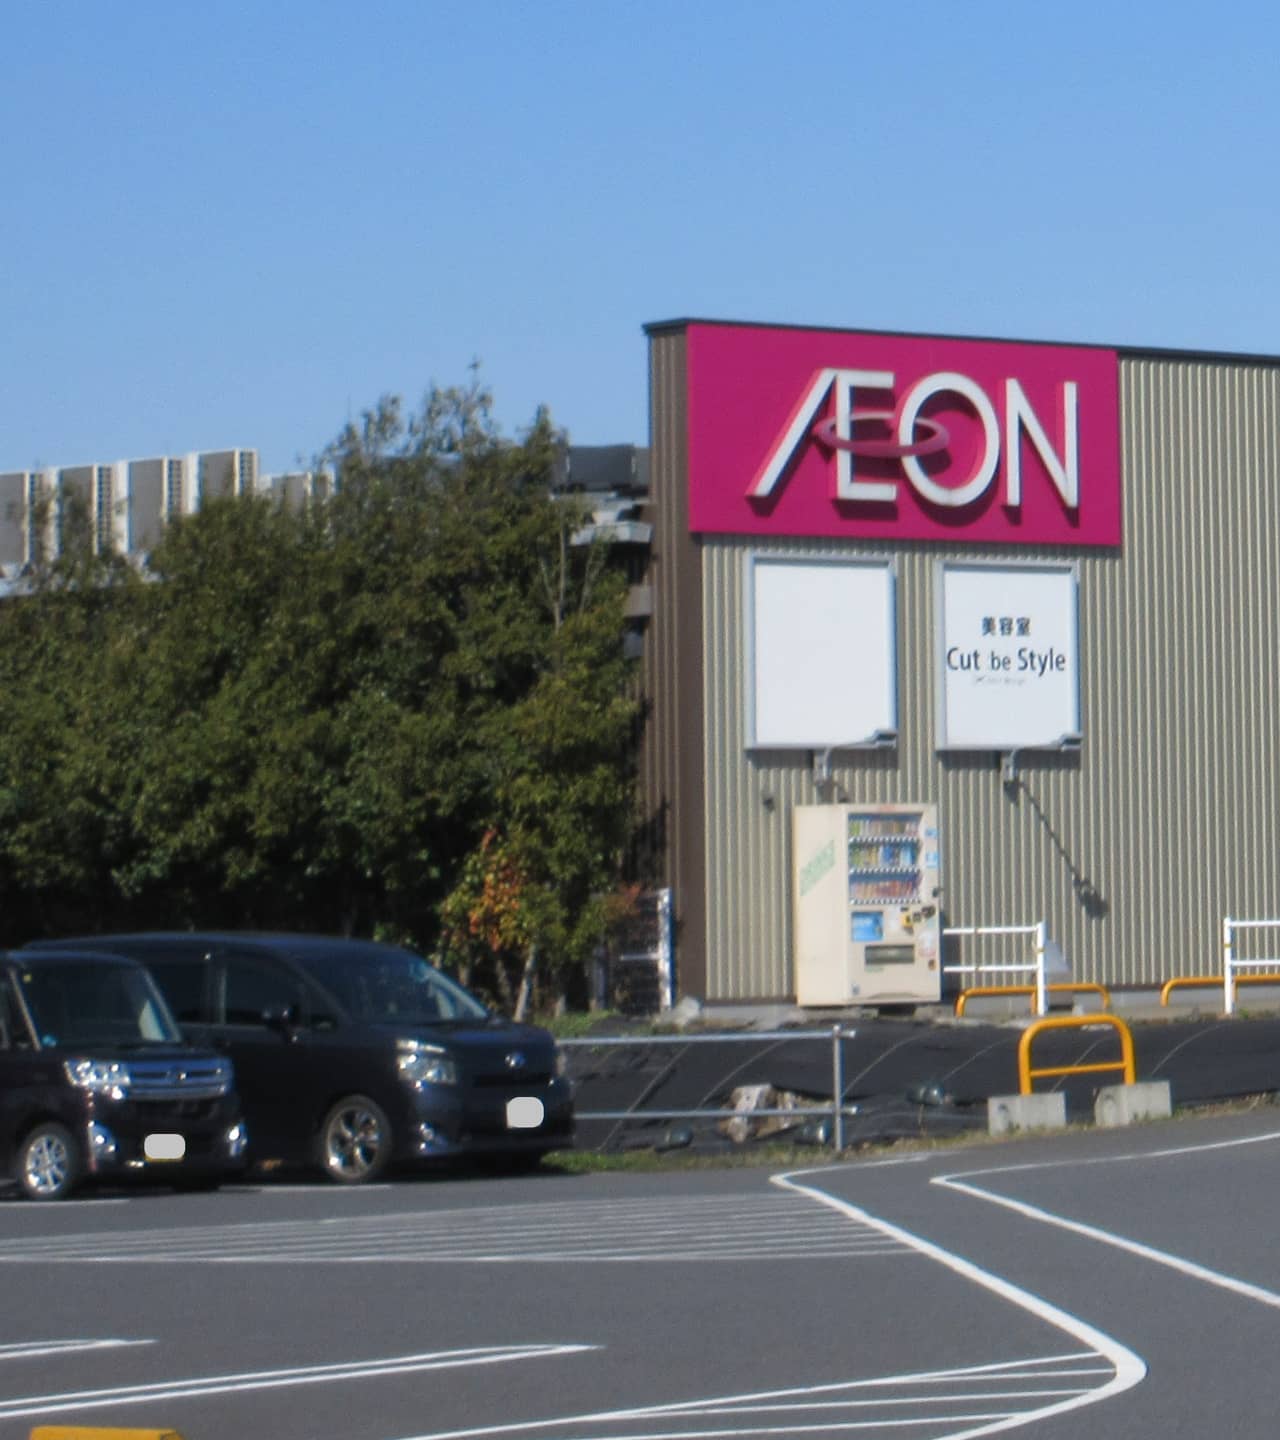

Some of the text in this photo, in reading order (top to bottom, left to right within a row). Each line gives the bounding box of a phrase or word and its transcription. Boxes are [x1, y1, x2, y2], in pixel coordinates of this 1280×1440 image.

[946, 646, 1066, 677] Cut be Style
